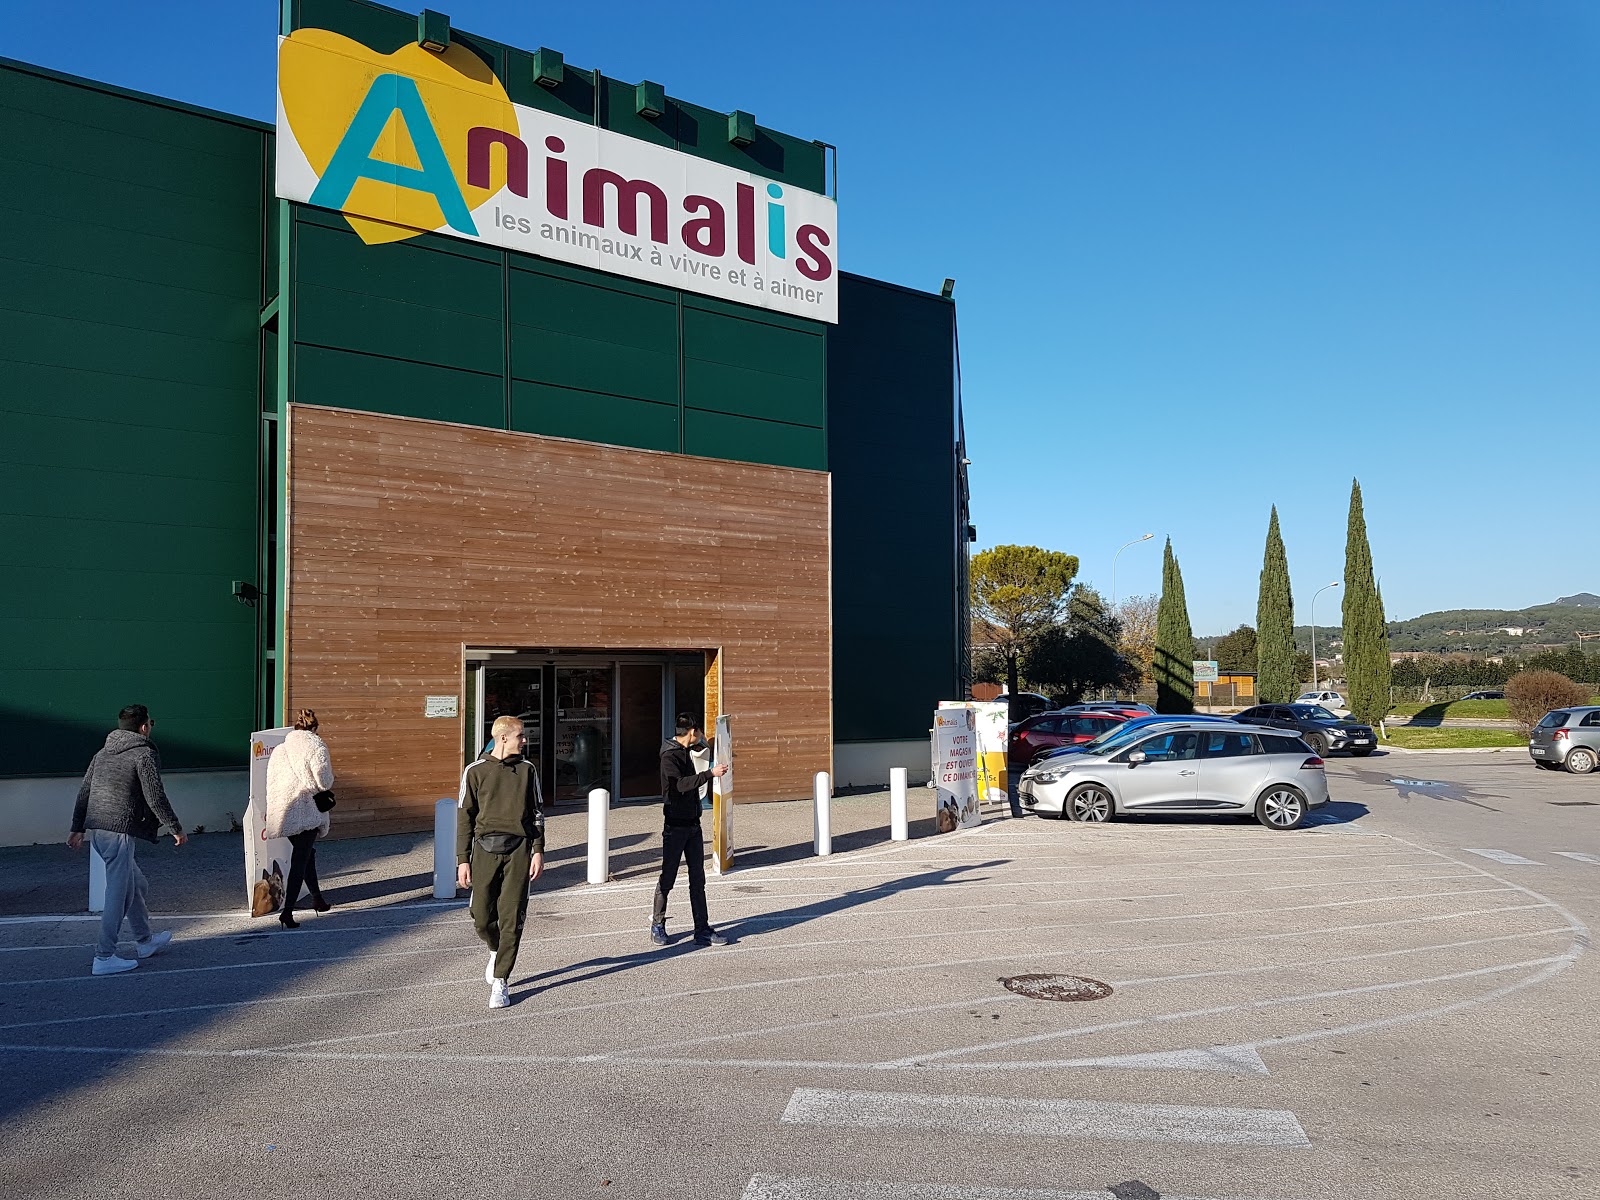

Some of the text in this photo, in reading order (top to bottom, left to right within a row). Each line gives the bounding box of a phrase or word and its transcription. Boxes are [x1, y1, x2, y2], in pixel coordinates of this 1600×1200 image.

[307, 73, 832, 281] Animalis
[495, 206, 824, 304] les animaux à vivre et à aimer
[952, 735, 968, 745] VOTRE
[256, 745, 275, 757] Anim
[950, 746, 972, 757] MAGASIN
[946, 758, 974, 770] EST OUVERT
[943, 770, 976, 782] CE DIMANCHE
